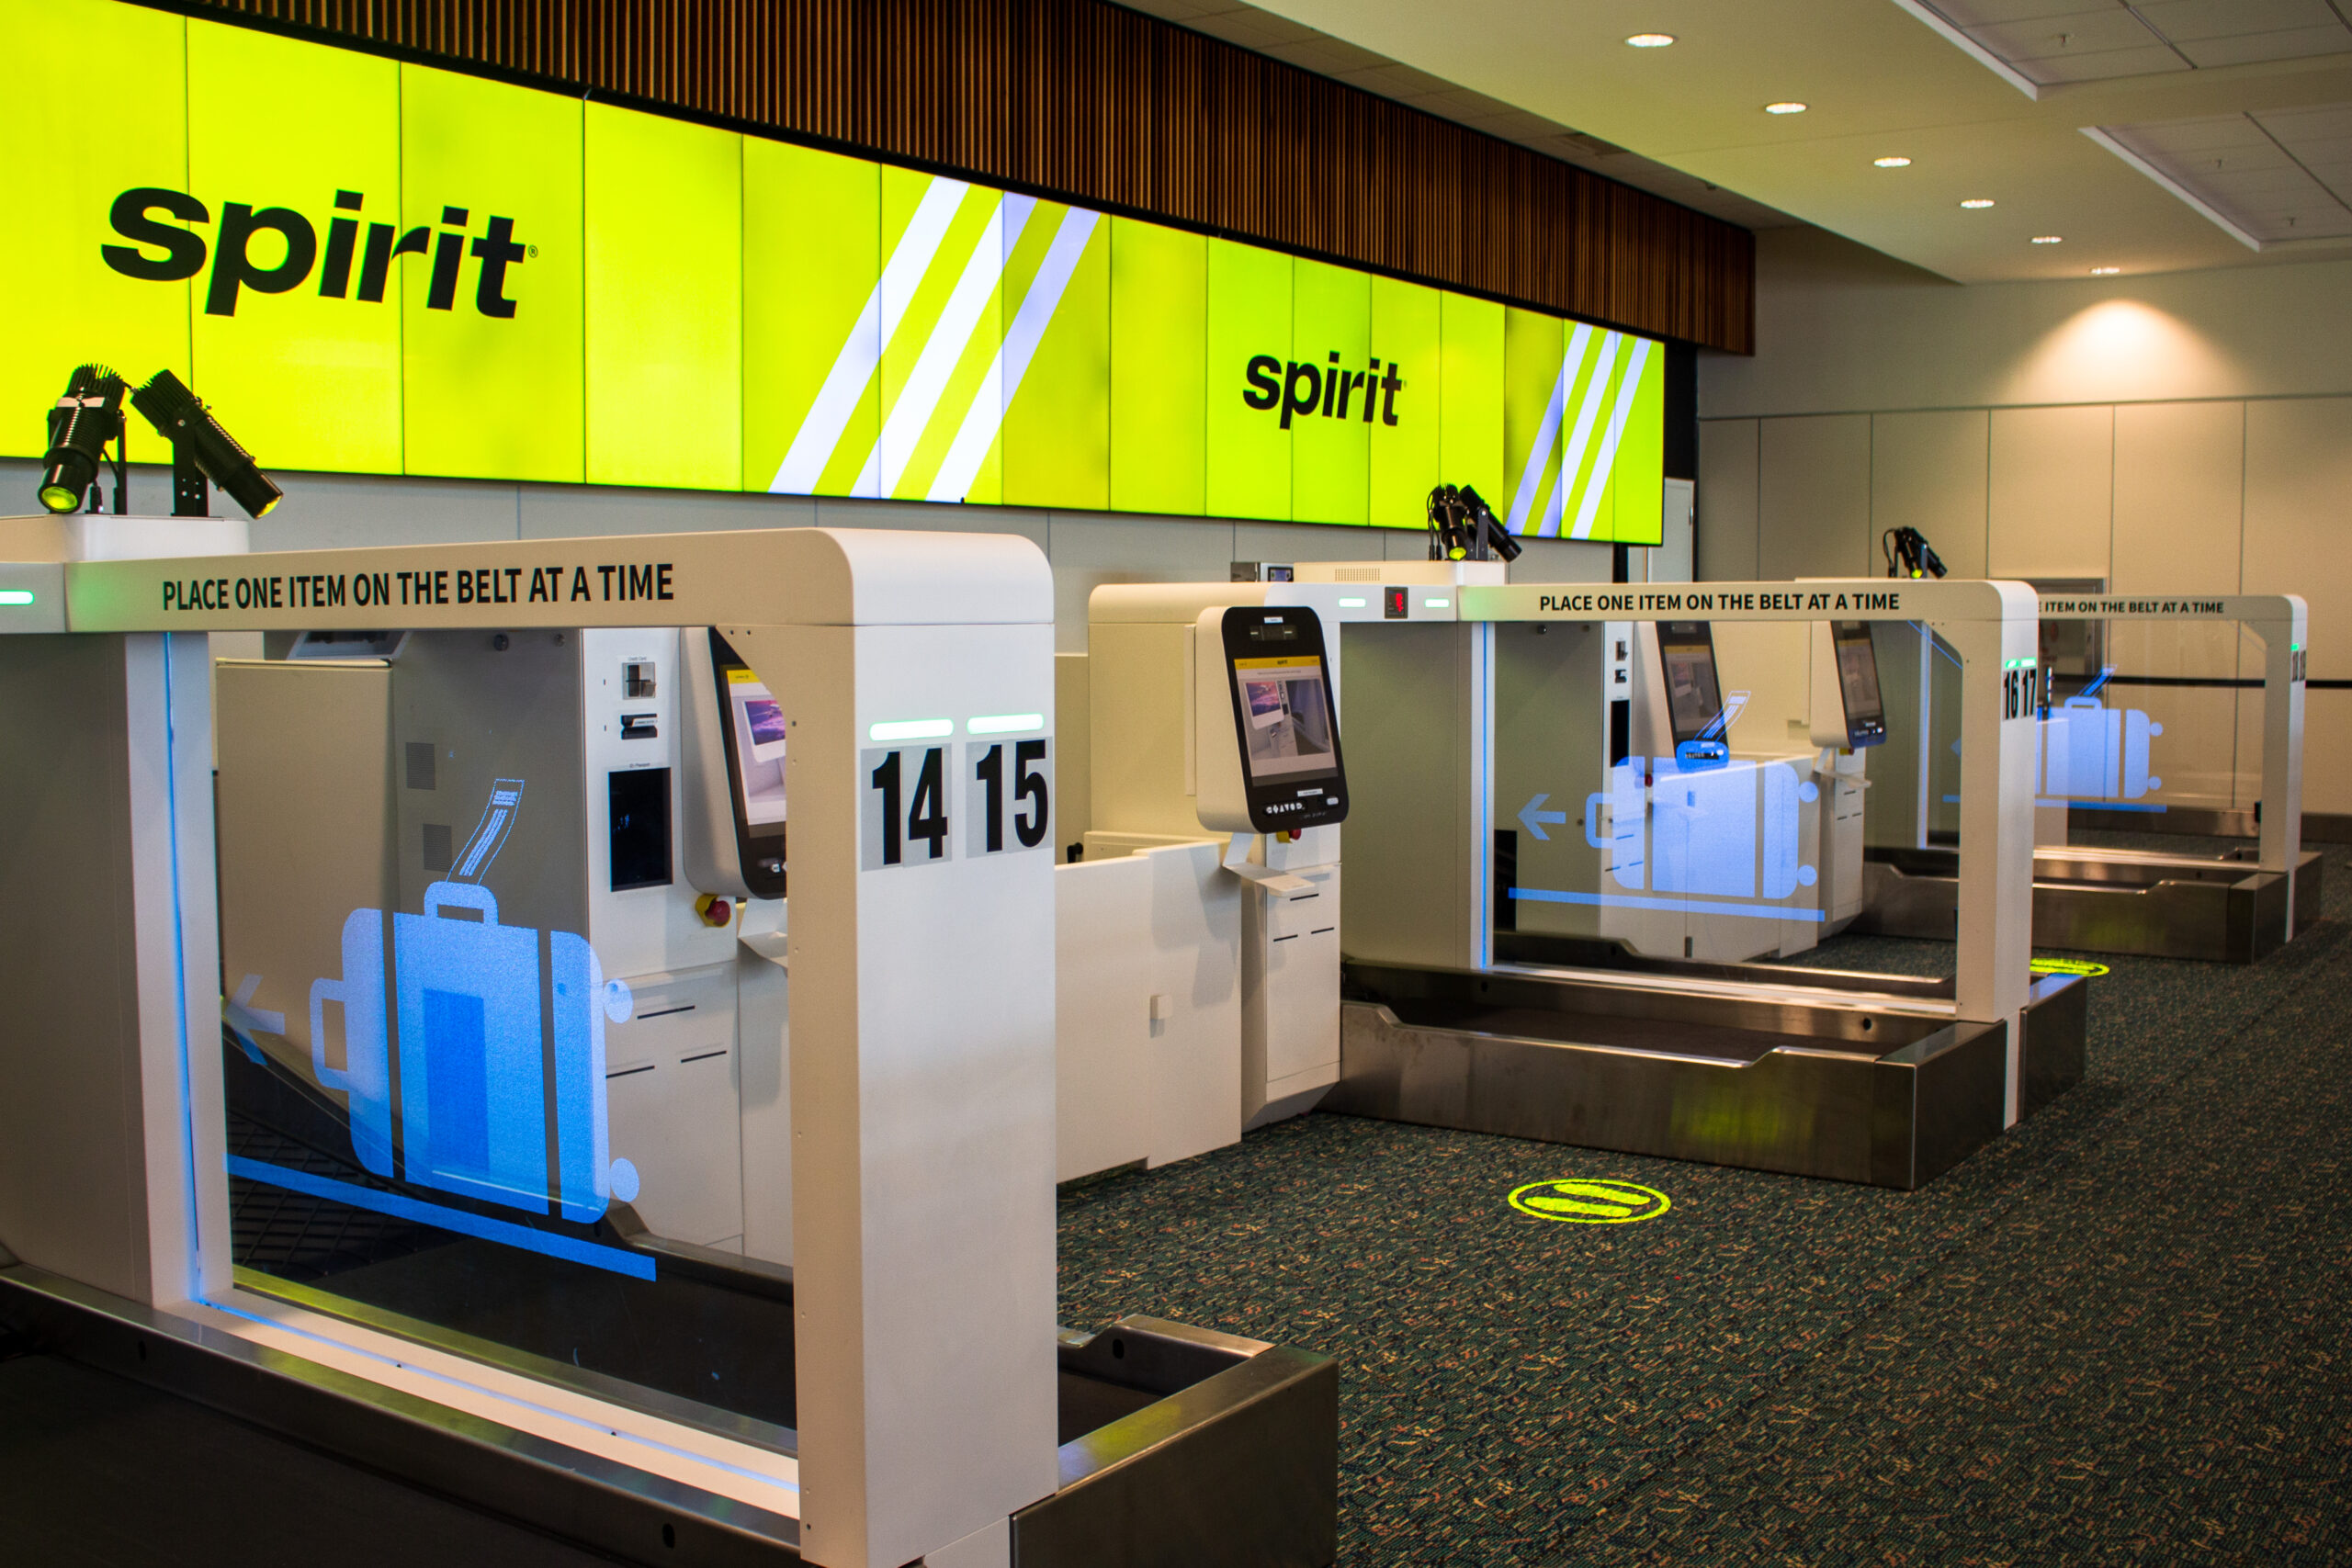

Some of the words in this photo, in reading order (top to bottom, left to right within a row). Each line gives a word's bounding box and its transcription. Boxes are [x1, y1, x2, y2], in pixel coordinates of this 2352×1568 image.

[1243, 351, 1403, 430] spirit
[163, 579, 230, 611] PLACE
[235, 577, 283, 610] ONE
[289, 574, 345, 608] ITEM
[353, 572, 390, 607] ON
[396, 570, 449, 605] THE
[457, 568, 522, 604] BELT
[528, 567, 564, 603] AT
[571, 566, 592, 602] A
[597, 563, 674, 602] TIME
[1540, 596, 1592, 611] PLACE
[1597, 595, 1634, 611] ONE
[1639, 595, 1681, 610] ITEM
[1686, 594, 1713, 610] ON
[1717, 594, 1754, 610] THE
[1759, 593, 1804, 610] BELT
[1807, 593, 1831, 610] AT
[1835, 593, 1848, 610] A
[1851, 593, 1900, 610] TIME
[2045, 602, 2075, 612] ITEM
[2078, 602, 2098, 613] ON
[2101, 602, 2125, 613] THE
[2129, 602, 2159, 613] BELT
[2161, 602, 2177, 613] AT
[2179, 602, 2189, 613] A
[2192, 602, 2223, 614] TIME
[2004, 670, 2018, 719] 16
[2022, 668, 2037, 716] 17
[872, 747, 948, 865] 14
[977, 739, 1048, 852] 15
